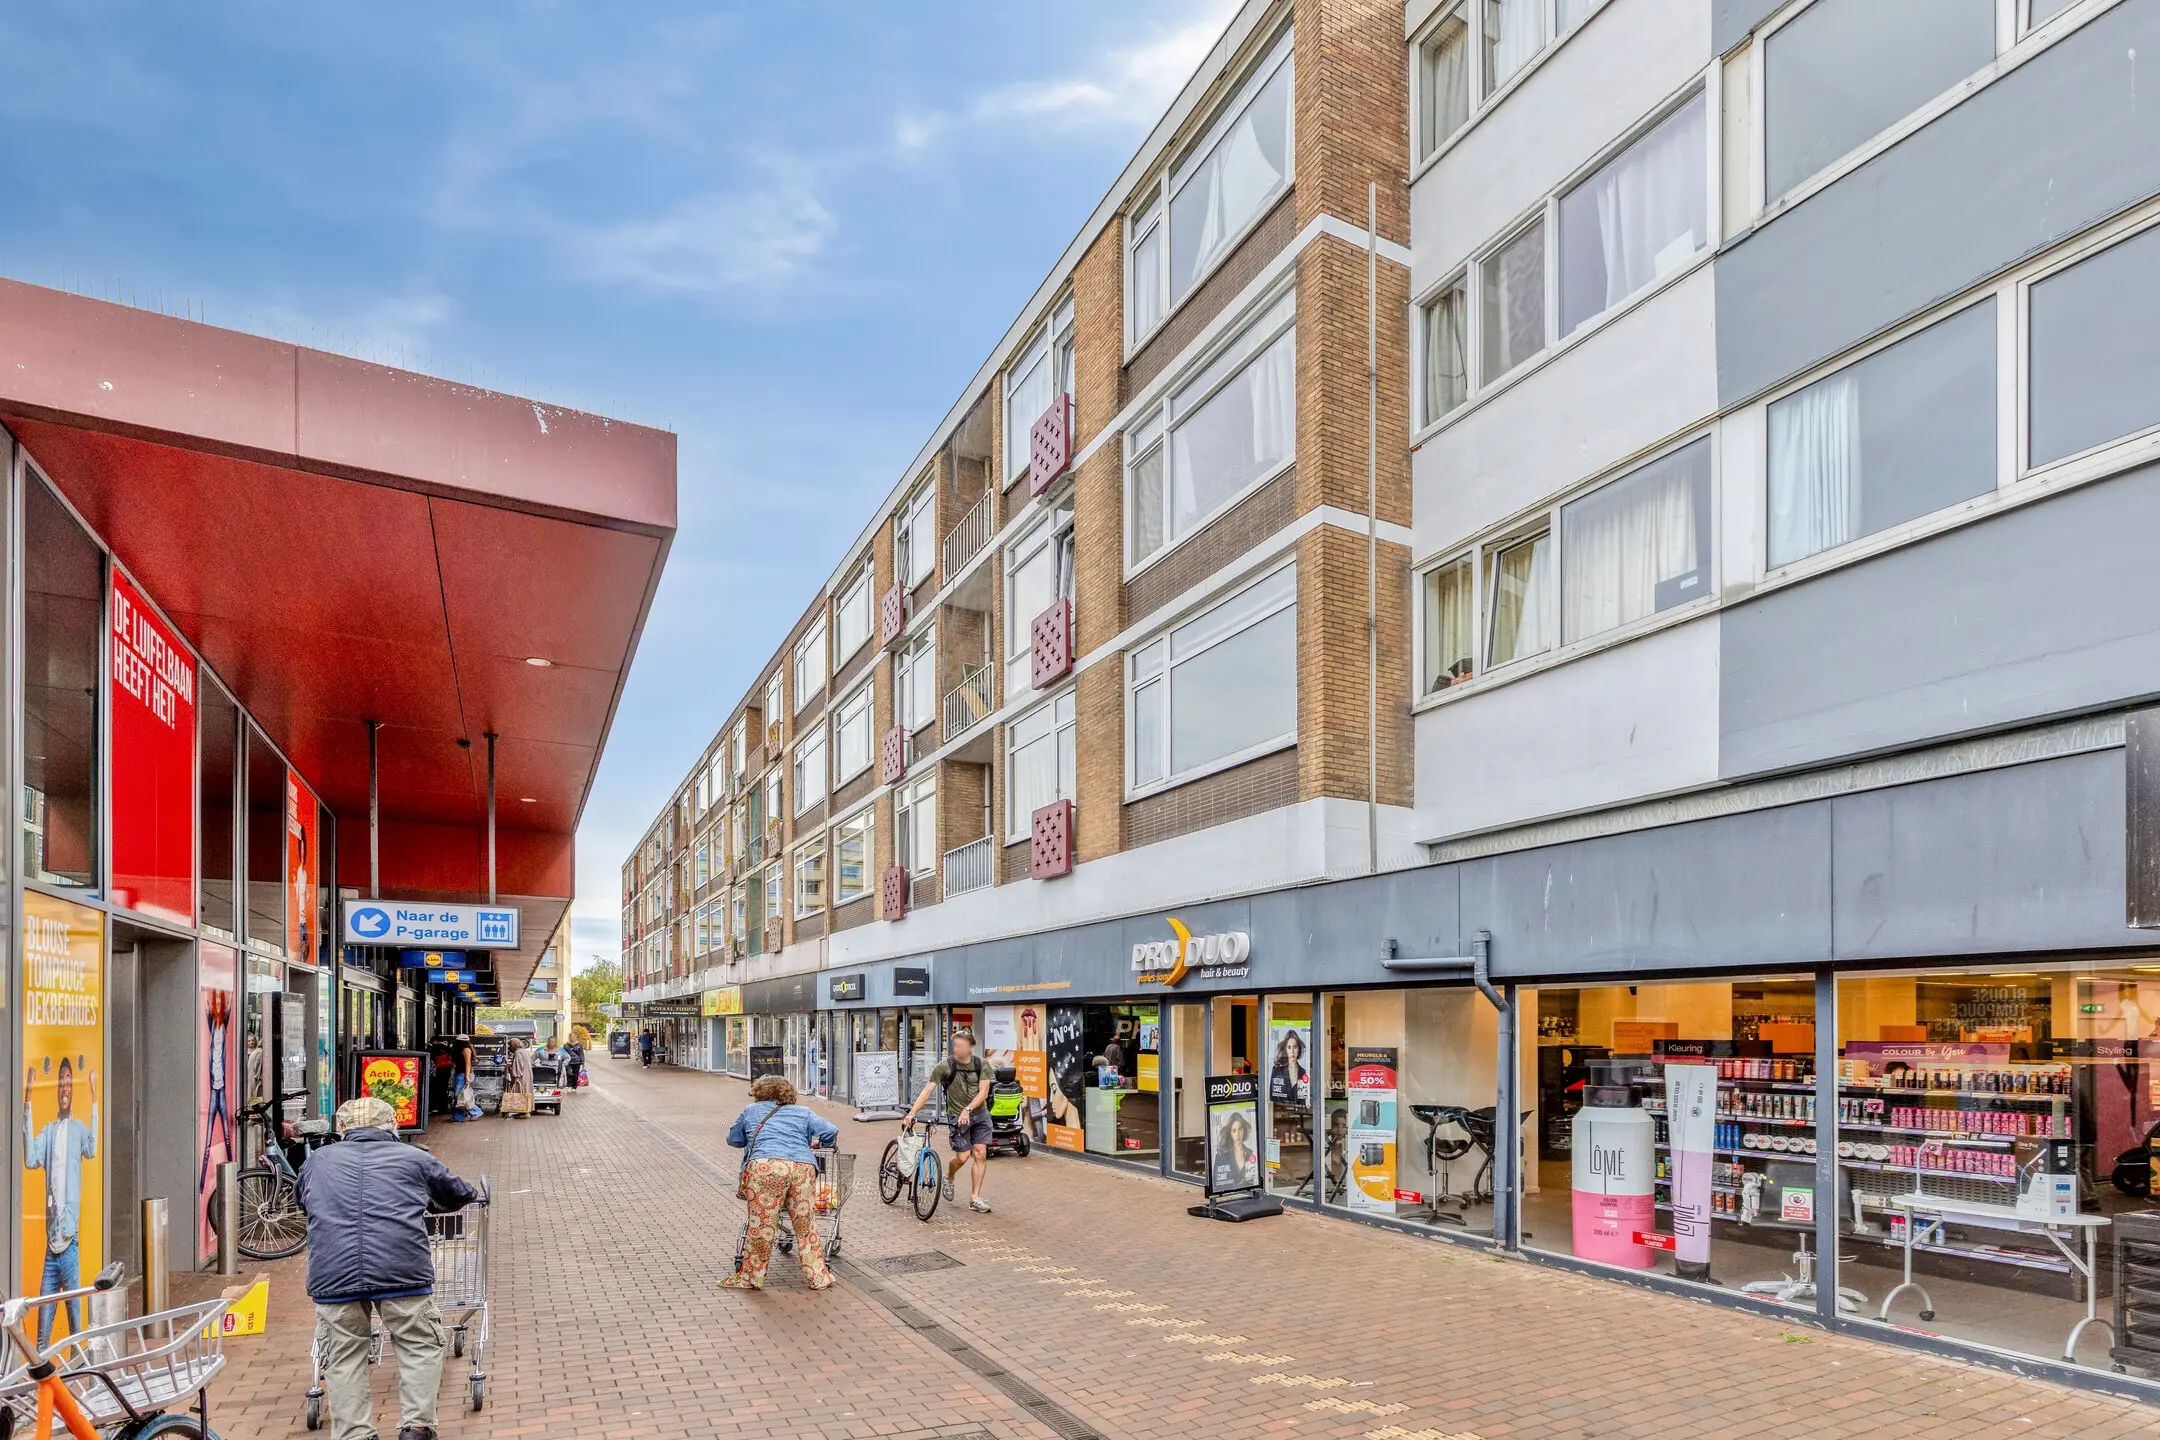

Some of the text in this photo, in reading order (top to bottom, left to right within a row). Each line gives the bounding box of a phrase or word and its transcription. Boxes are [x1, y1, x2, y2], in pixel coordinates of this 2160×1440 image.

[114, 587, 192, 705] DE LUIFELBAAN
[114, 636, 175, 729] HEEFT HET!
[397, 910, 459, 922] Naar de
[27, 915, 71, 956] BLOUSE
[397, 926, 469, 940] P-garage
[26, 952, 86, 992] TOMPOUCE
[1200, 968, 1215, 979] hair
[1216, 968, 1221, 978] &
[1222, 966, 1250, 978] beauty
[26, 990, 97, 1026] DEKBEDHOES
[1668, 1044, 1703, 1054] Kleuring
[1925, 1049, 1936, 1057] By
[1941, 1045, 1966, 1060] You
[2097, 1046, 2133, 1056] Styling
[370, 1070, 396, 1078] Actie
[1211, 1082, 1251, 1094] PRO DUO
[1589, 1121, 1625, 1194] LÔMÉ
